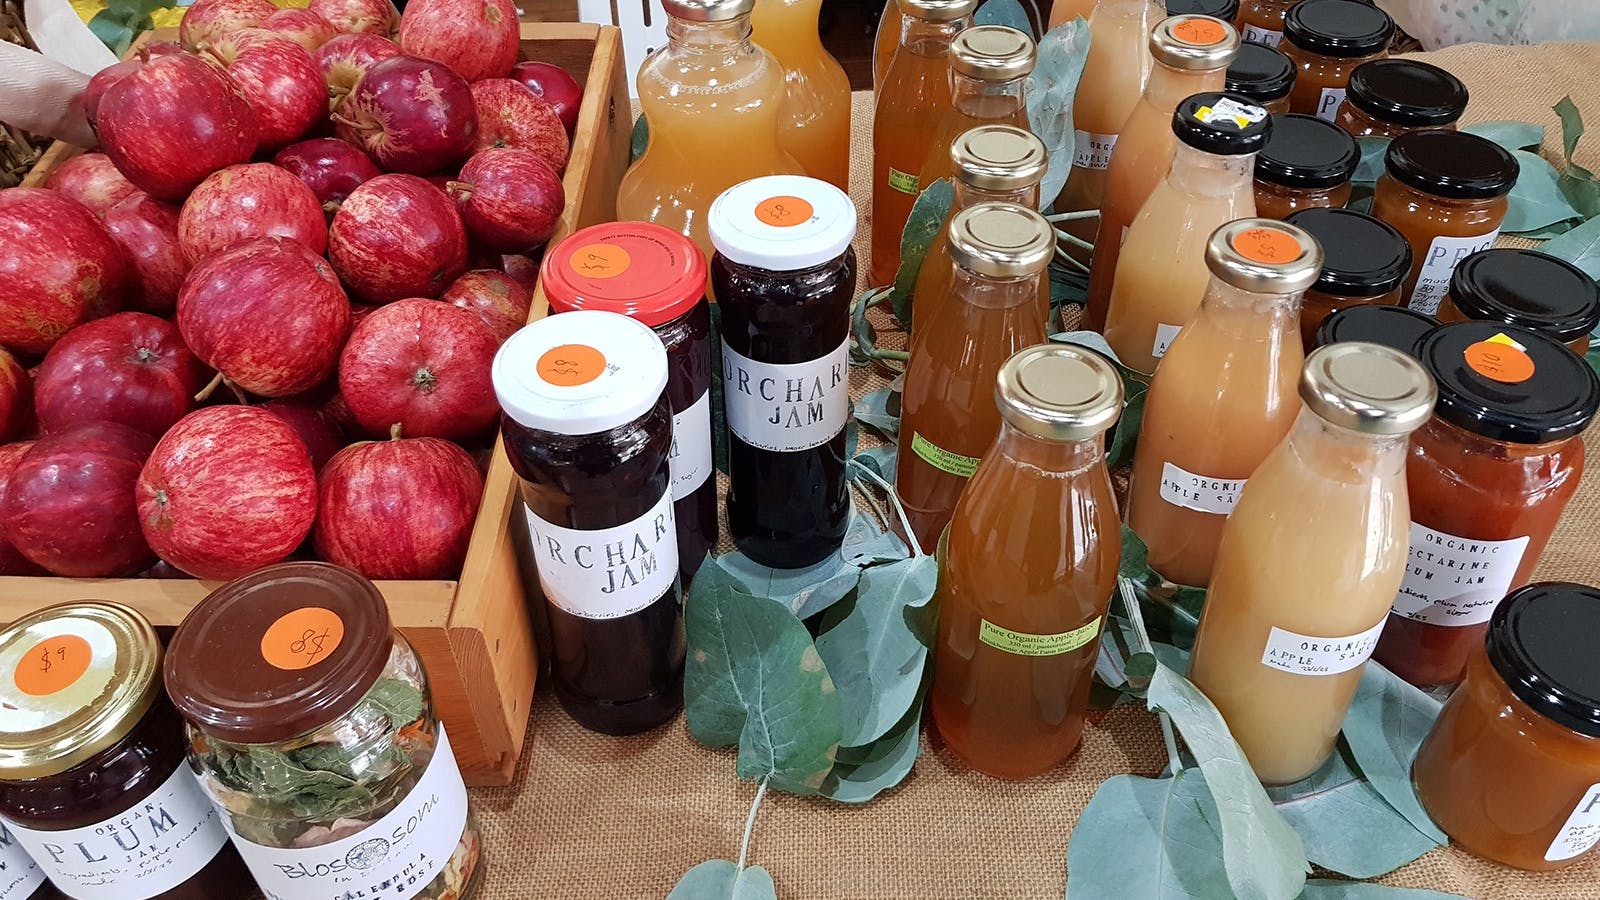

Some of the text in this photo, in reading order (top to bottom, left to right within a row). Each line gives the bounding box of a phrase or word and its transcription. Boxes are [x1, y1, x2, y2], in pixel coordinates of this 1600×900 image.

[768, 401, 824, 428] JAM
[1163, 479, 1200, 501] APPLE
[1426, 534, 1499, 554] ORGANIC
[1409, 546, 1489, 570] ECTARINE
[601, 552, 657, 593] JAM
[1405, 563, 1485, 584] LUM JAM
[984, 622, 1004, 637] Pure
[1006, 630, 1045, 643] Organic
[1047, 630, 1073, 643] Apple
[1300, 637, 1369, 653] ORGANIC
[1270, 648, 1313, 666] APPLE
[95, 793, 174, 836] ORGAN
[42, 807, 178, 864] PLUM
